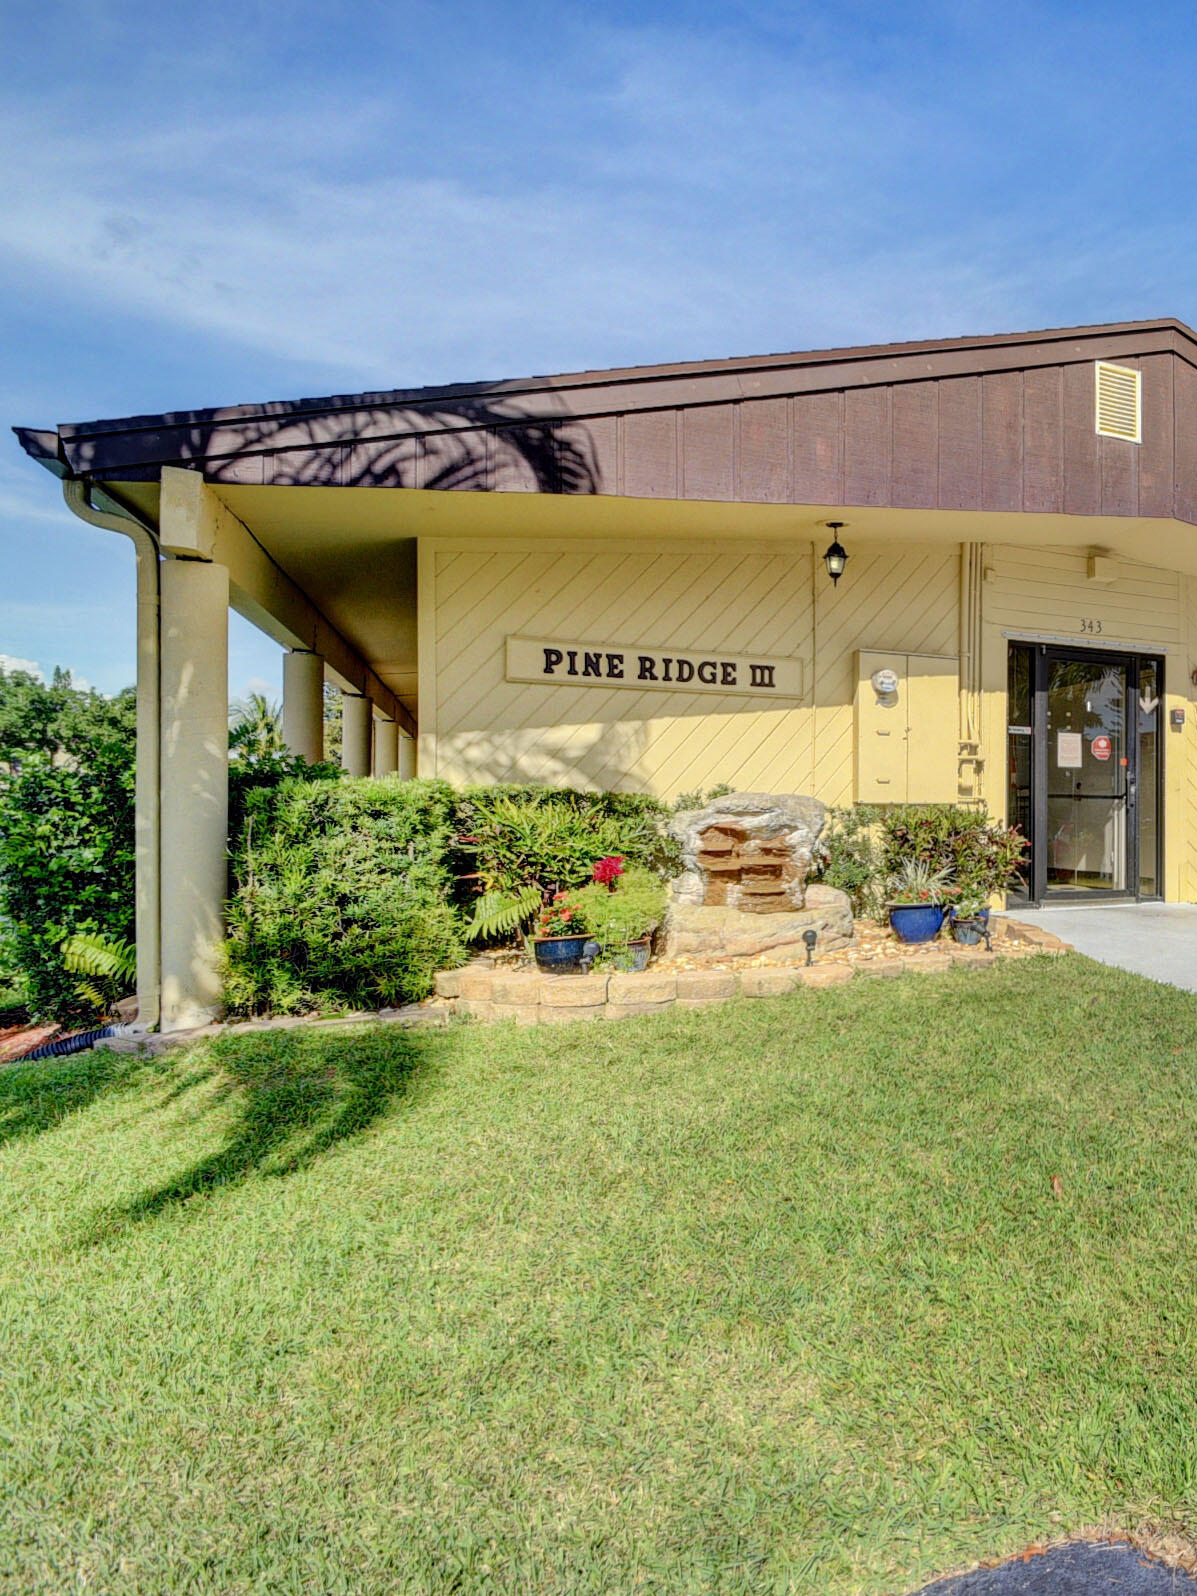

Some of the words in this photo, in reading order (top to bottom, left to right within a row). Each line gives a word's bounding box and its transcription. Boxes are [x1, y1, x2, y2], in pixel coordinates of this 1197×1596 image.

[1079, 618, 1102, 634] 343
[543, 648, 624, 679] PINE
[637, 656, 737, 686] RIDGE
[749, 664, 776, 688] III
